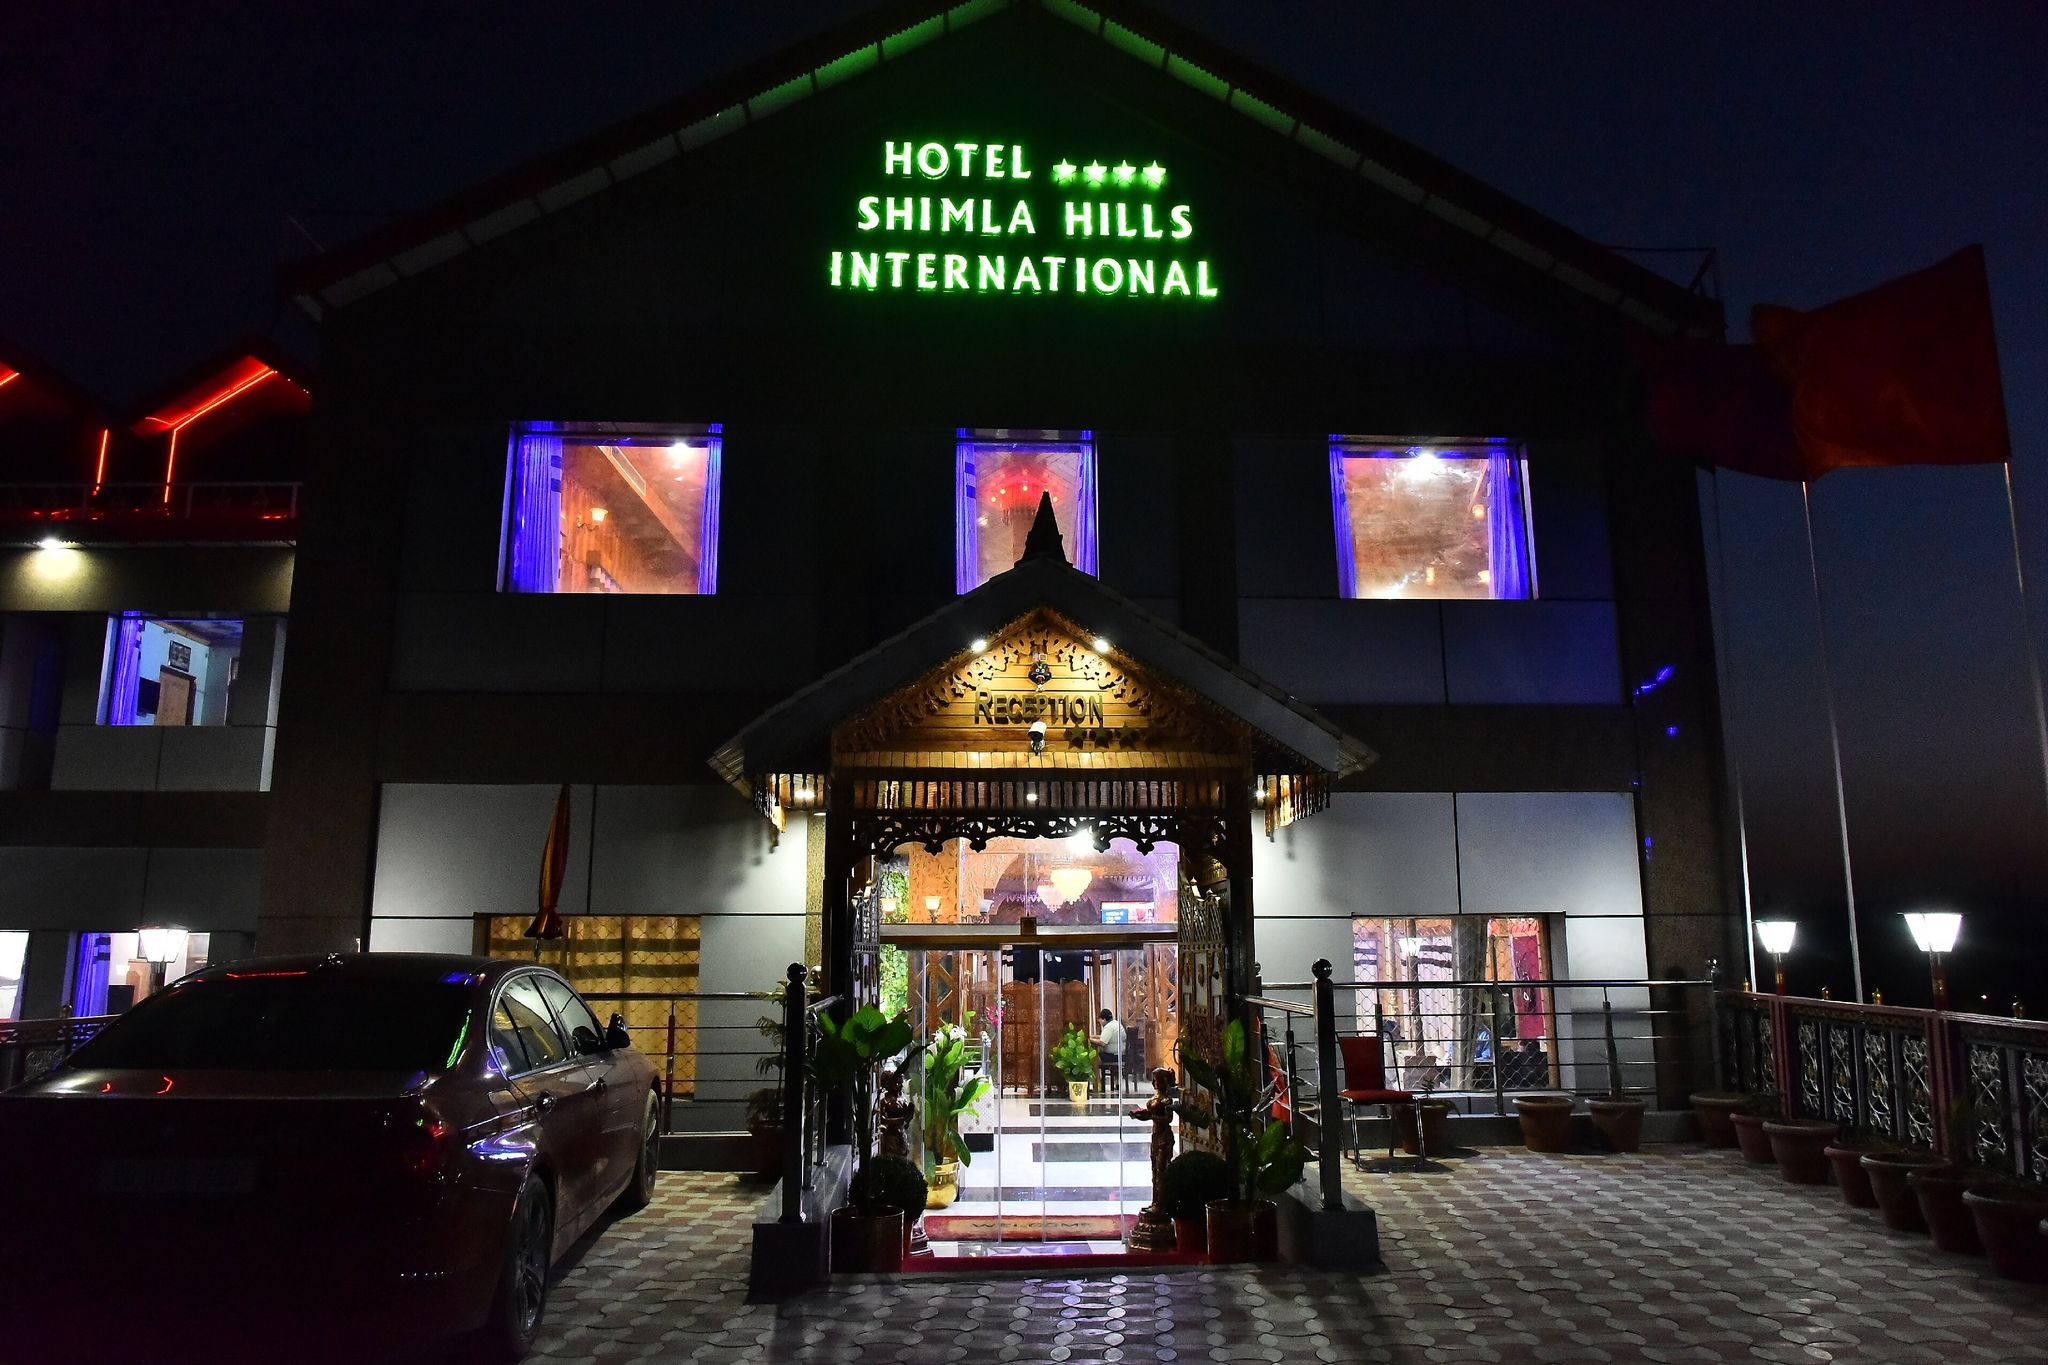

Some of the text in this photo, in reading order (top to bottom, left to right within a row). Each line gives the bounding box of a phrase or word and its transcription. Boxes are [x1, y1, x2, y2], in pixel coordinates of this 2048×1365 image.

[884, 140, 1032, 180] HOTEL
[856, 195, 1194, 240] SHIMLA HILLS
[829, 250, 1220, 298] INTERNATIONAL
[975, 690, 1104, 724] RECEPTION
